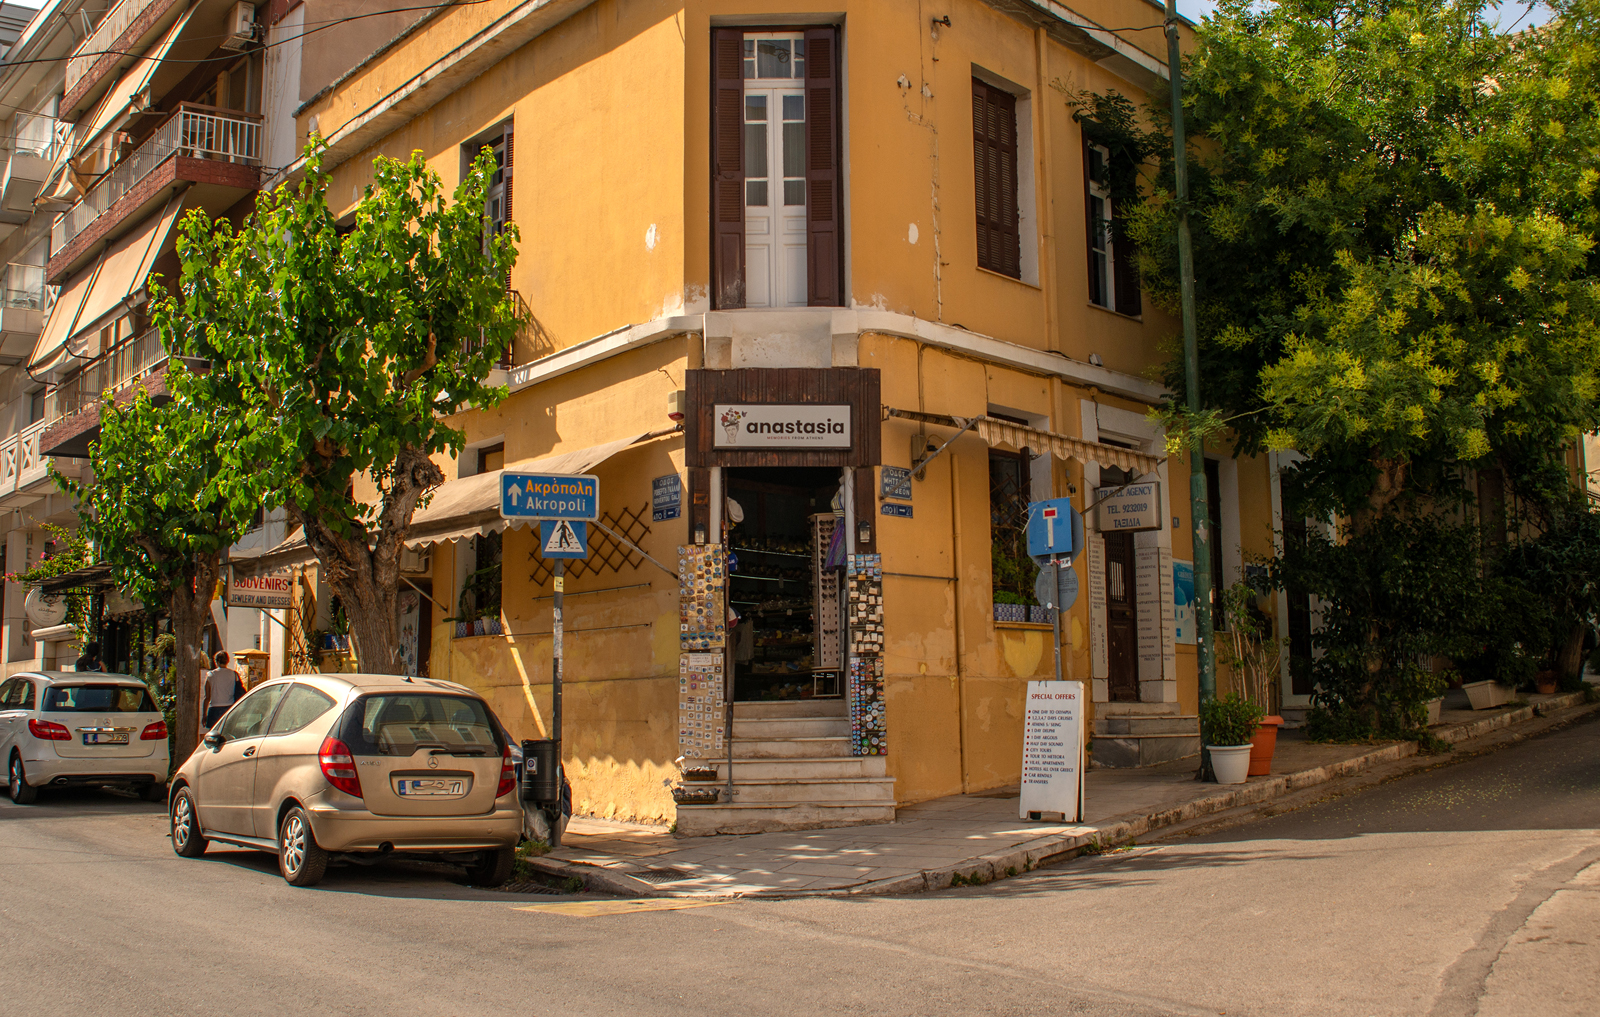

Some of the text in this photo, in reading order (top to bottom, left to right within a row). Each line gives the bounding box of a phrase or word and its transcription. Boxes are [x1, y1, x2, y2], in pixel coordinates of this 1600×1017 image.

[746, 418, 844, 434] anastasia
[526, 480, 593, 497] Ακρόπολη
[1126, 486, 1152, 497] AGENCY
[526, 496, 586, 513] Akropoli
[1107, 503, 1148, 514] TEL. 9232019
[1114, 518, 1141, 528] ΤΑΞΙΔΙΑ
[234, 577, 288, 591] SOUVENIRS
[231, 594, 291, 606] JEWLERY AND DRESSES
